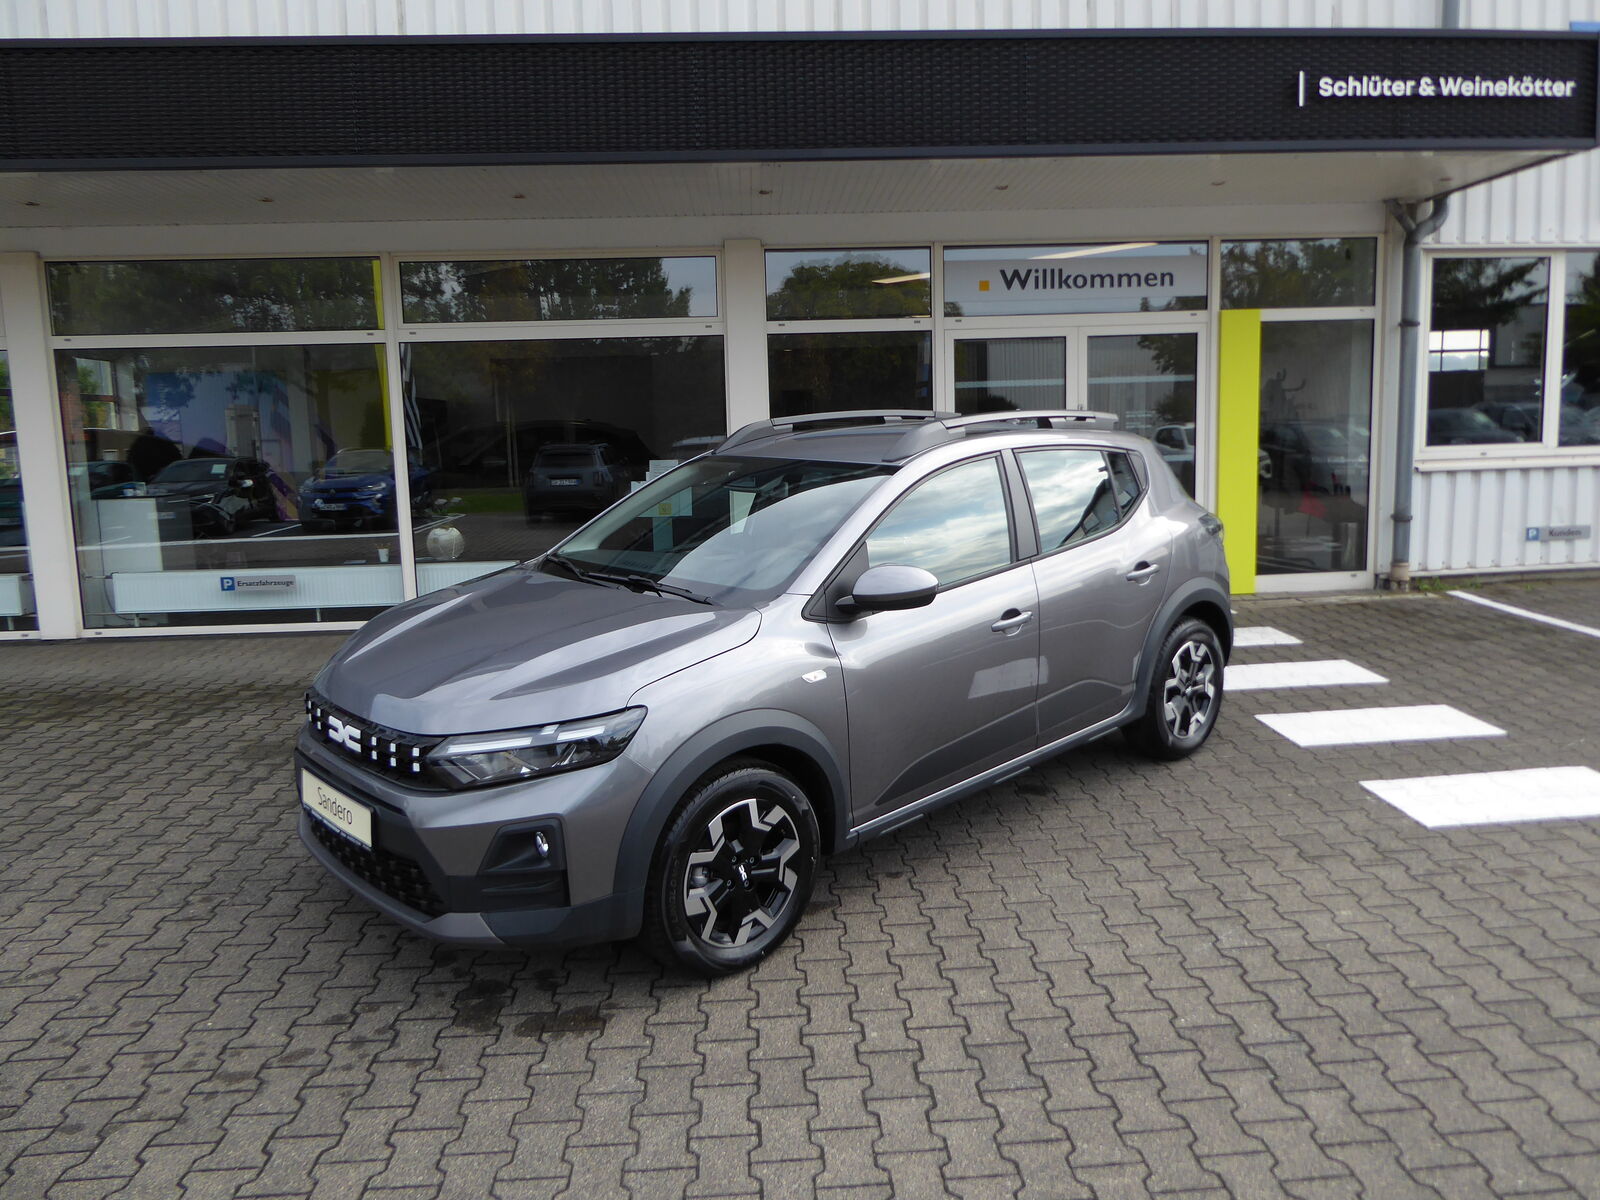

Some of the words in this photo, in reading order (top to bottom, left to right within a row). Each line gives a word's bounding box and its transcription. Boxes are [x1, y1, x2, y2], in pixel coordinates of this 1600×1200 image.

[1318, 75, 1416, 97] Schlüter
[1418, 76, 1436, 97] &
[1439, 75, 1576, 97] Weinekötter
[999, 268, 1175, 290] Willkommen
[317, 786, 353, 825] Sandero
